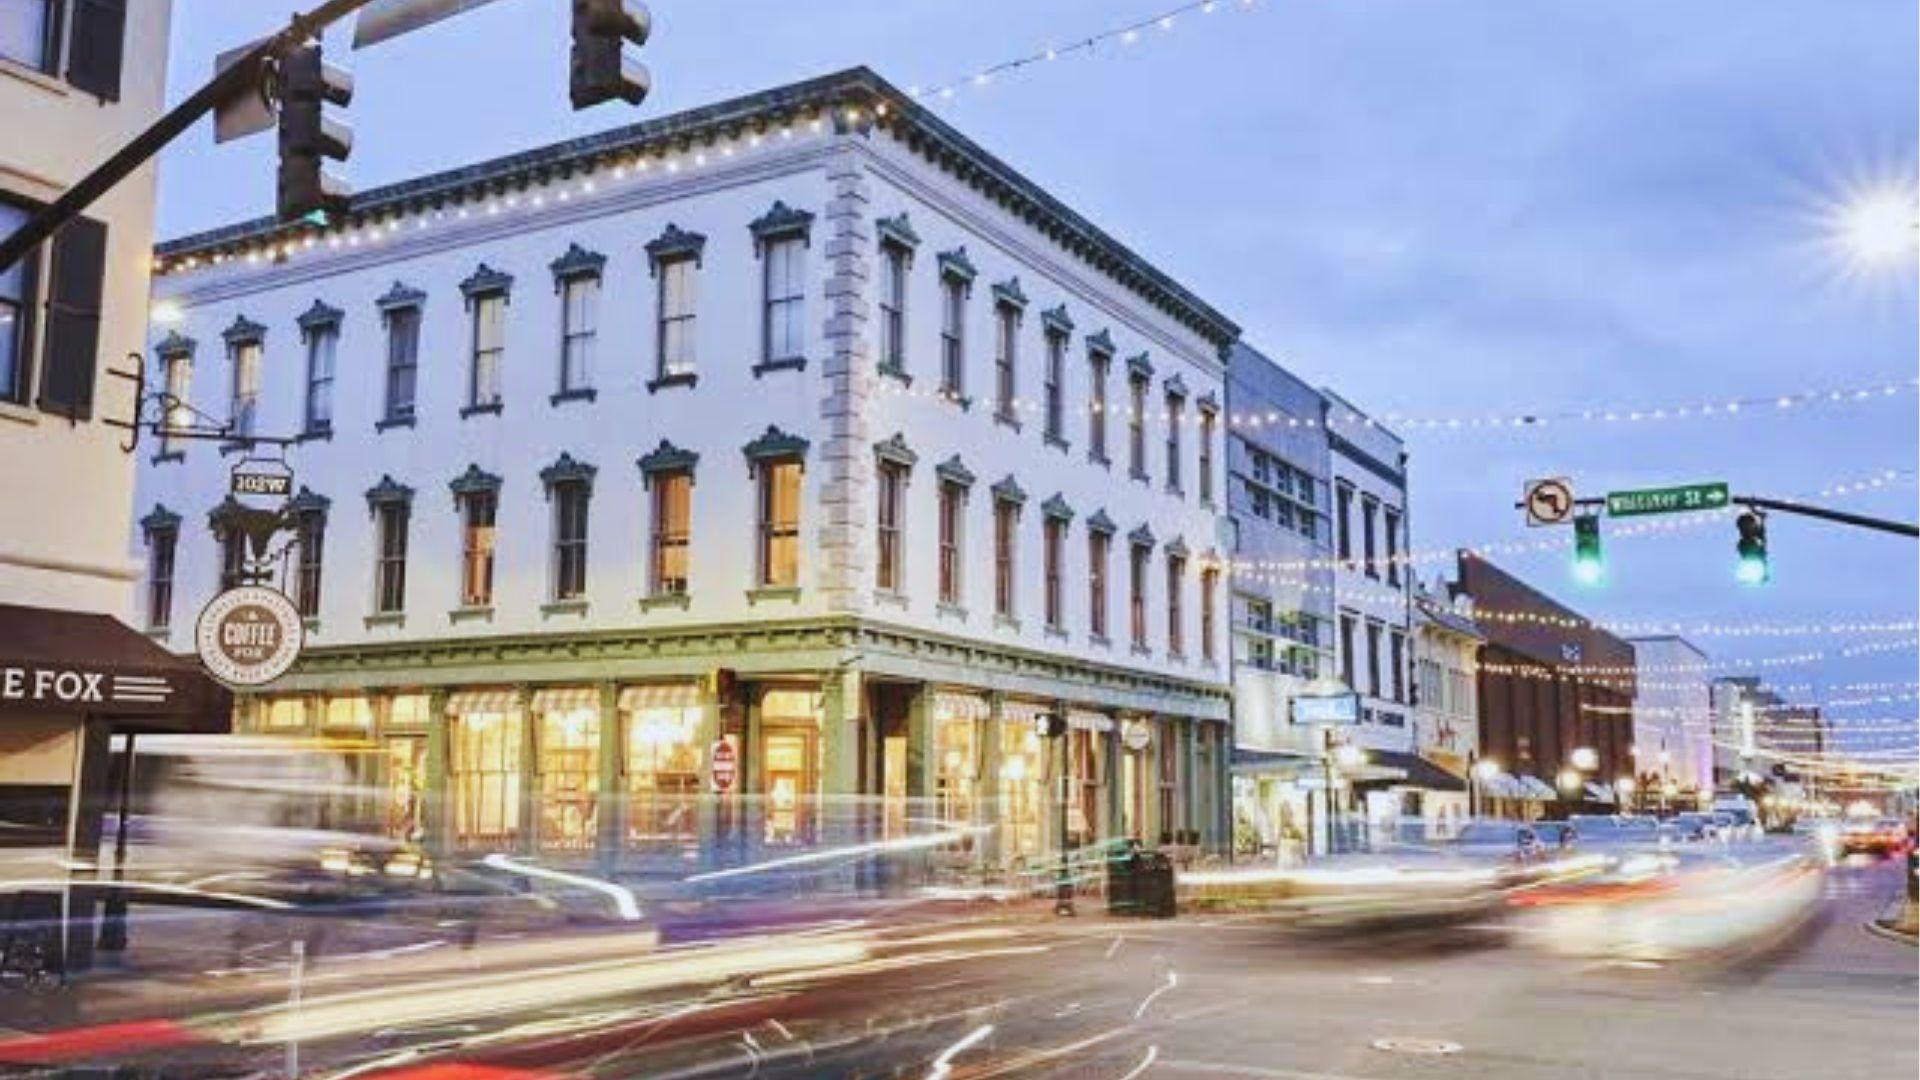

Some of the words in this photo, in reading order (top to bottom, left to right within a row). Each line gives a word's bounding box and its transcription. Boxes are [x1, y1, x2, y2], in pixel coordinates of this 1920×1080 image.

[222, 621, 276, 646] COFFEE
[231, 647, 262, 659] FOX
[33, 669, 104, 702] FOX
